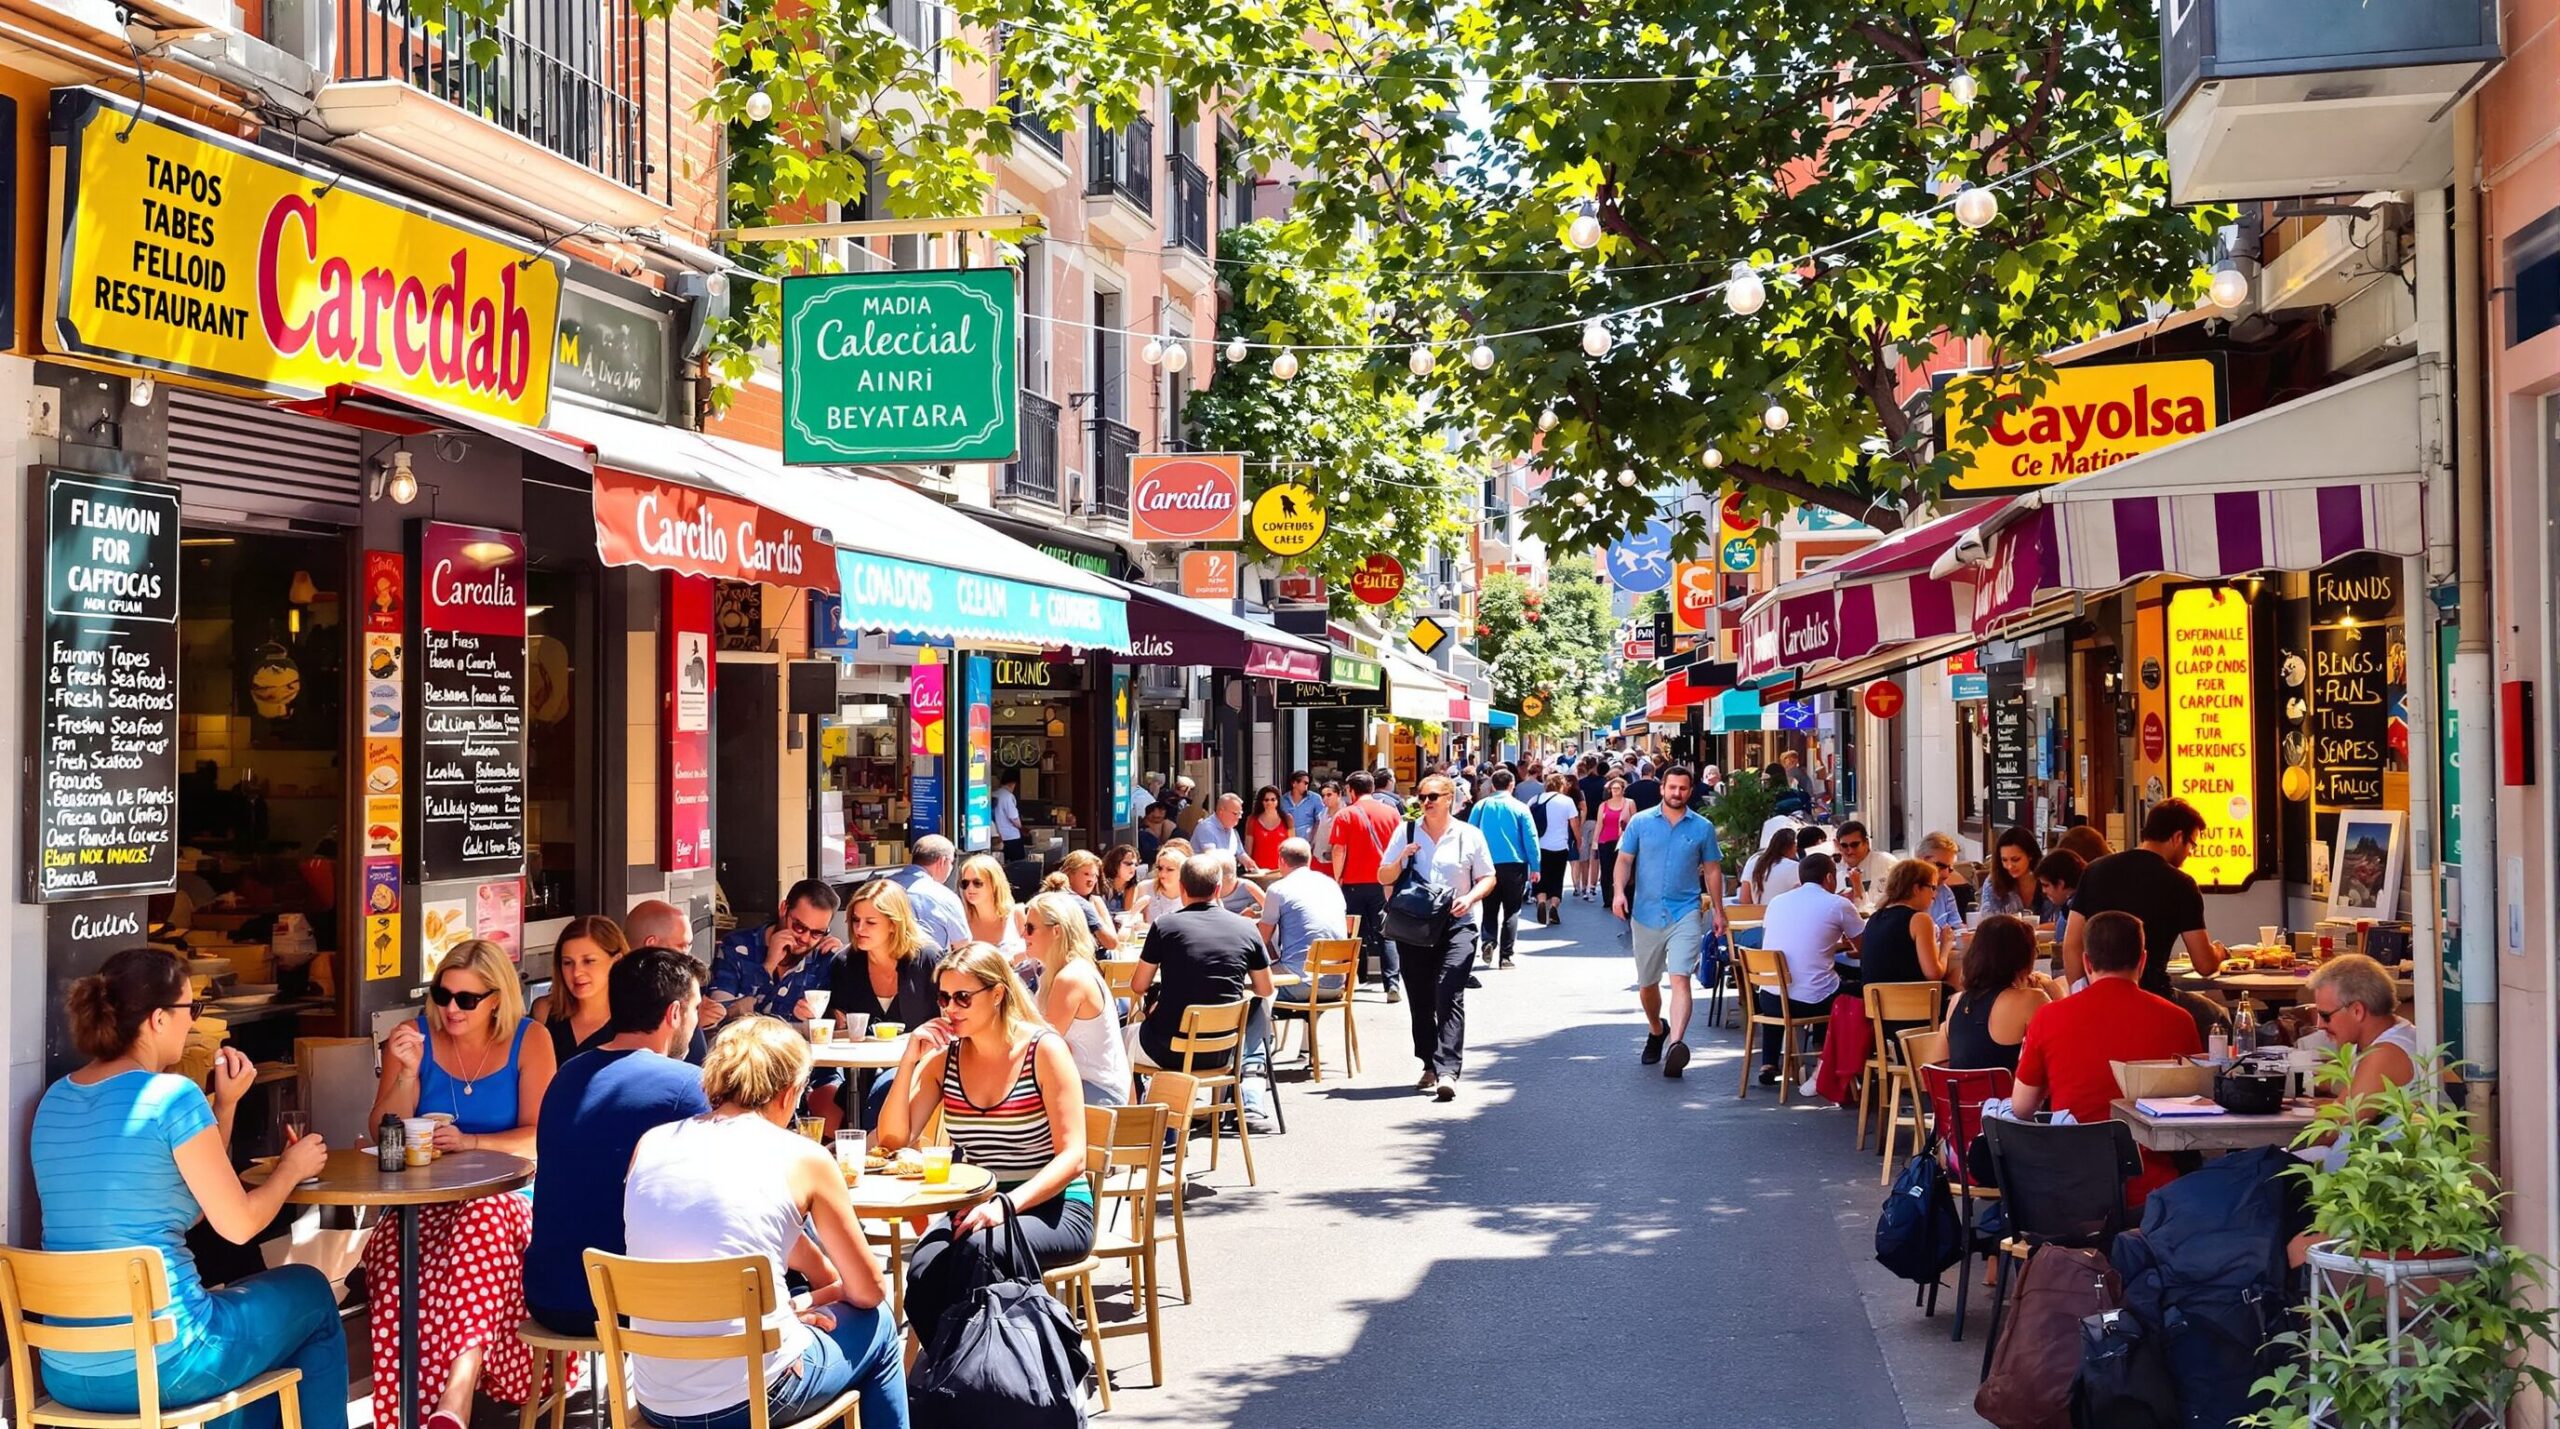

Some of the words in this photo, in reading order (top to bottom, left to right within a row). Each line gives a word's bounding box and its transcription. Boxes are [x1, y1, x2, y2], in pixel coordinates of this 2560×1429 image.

[146, 154, 222, 207] TAPOS
[142, 198, 215, 247] TABES
[133, 240, 226, 293] FELLOID
[95, 275, 249, 340] RESTAURANT
[863, 296, 932, 316] MADIA
[1985, 383, 2206, 454] Cayolsa
[2012, 452, 2043, 477] Ce
[70, 498, 160, 536] FLEAVOIN
[92, 536, 131, 565] FOR
[737, 520, 803, 575] Cardis
[67, 565, 162, 599] CAFFOCAS
[431, 558, 517, 607] Carcalia
[49, 666, 62, 683] &
